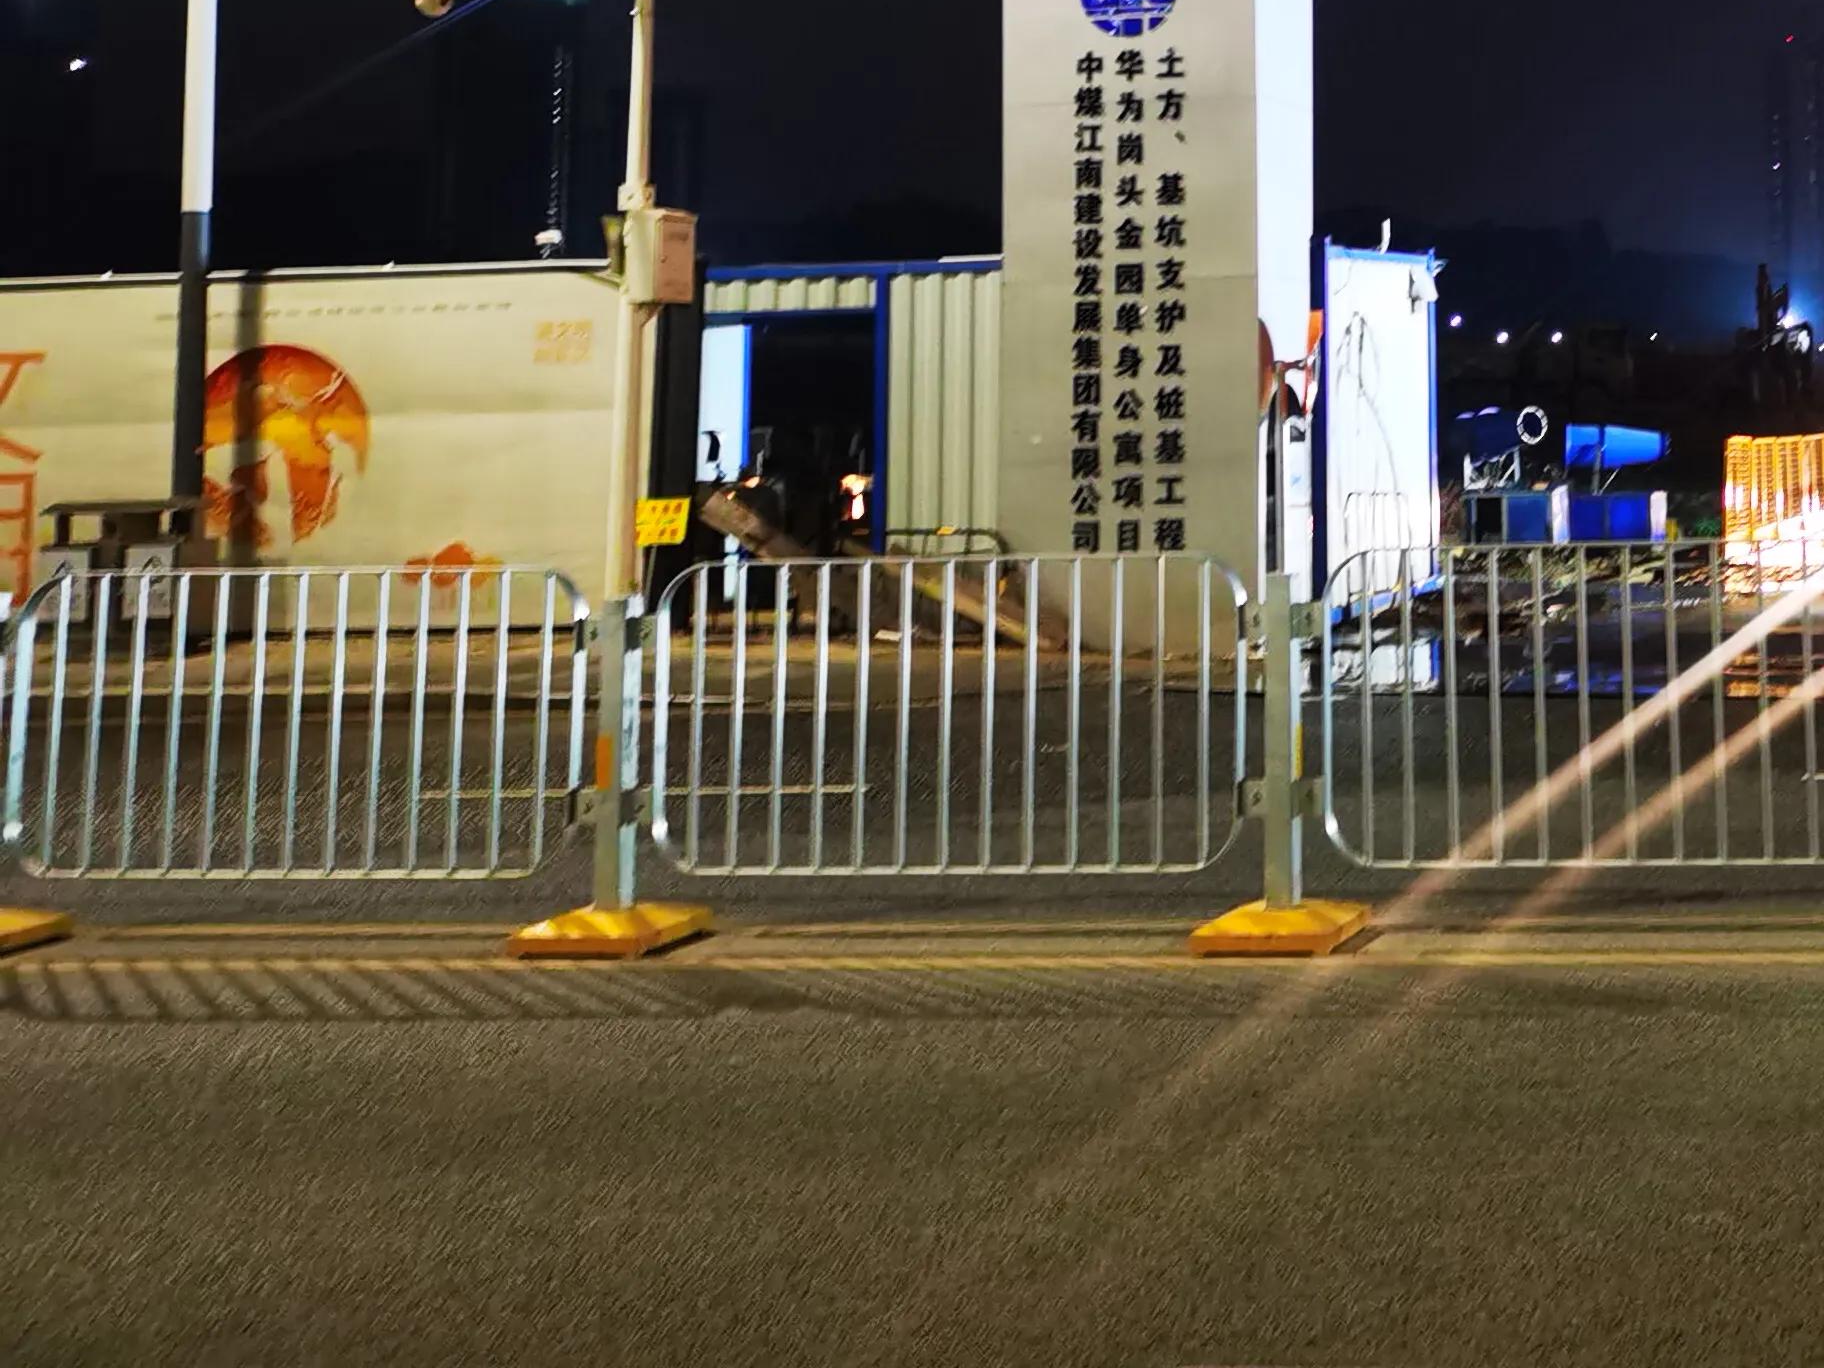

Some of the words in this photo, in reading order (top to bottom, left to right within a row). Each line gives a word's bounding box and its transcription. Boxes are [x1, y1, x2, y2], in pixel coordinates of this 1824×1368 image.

[1071, 50, 1104, 553] 中煤江南建设发展集团有限公司
[1111, 49, 1145, 552] 华为岗头金园单身公寓项目
[1154, 46, 1186, 551] 土方、基坑支护及桩基工程
